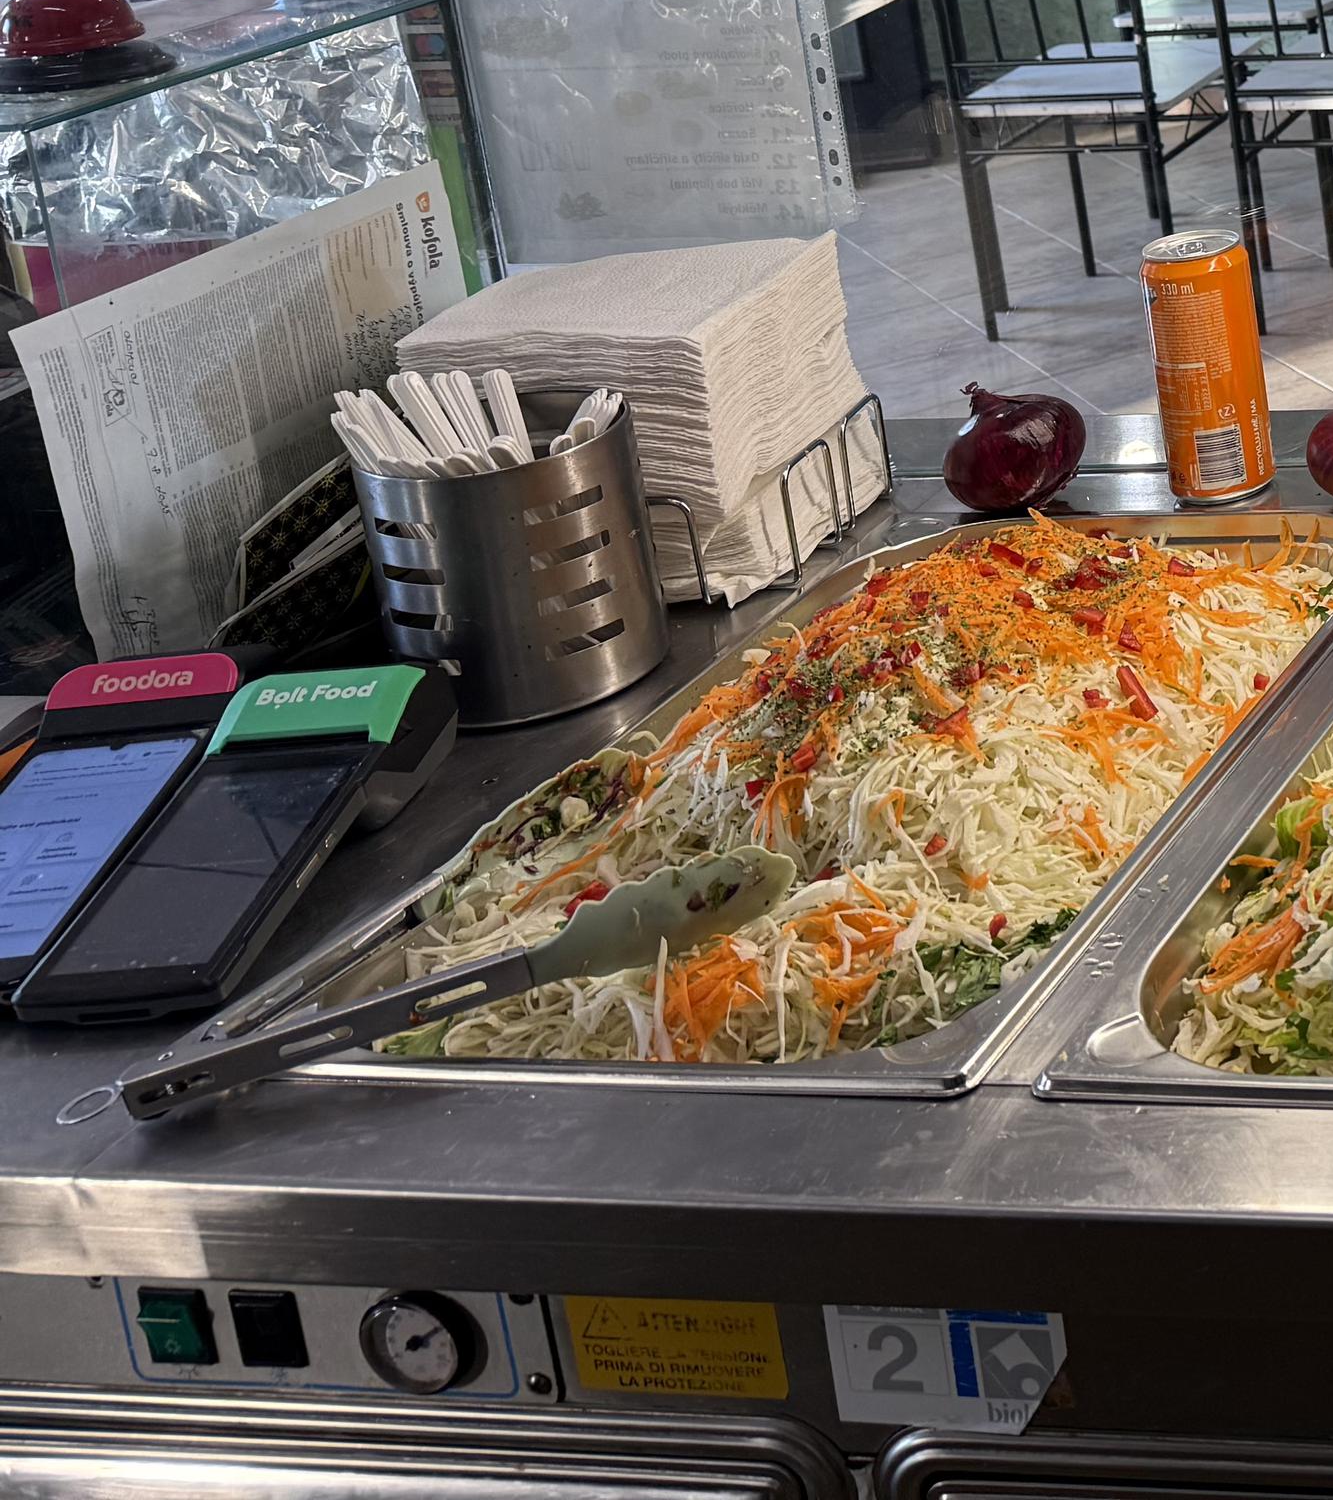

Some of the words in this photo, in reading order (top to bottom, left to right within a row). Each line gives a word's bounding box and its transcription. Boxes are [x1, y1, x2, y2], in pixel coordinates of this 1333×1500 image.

[396, 202, 414, 257] Smlouva
[420, 215, 443, 270] kofola
[1160, 283, 1178, 296] 330
[1180, 282, 1195, 295] ml
[92, 670, 194, 695] foodora
[255, 687, 308, 709] Bolt
[310, 681, 378, 702] Food
[594, 1359, 645, 1373] PRIMA
[649, 1359, 665, 1373] DI
[669, 1362, 765, 1378] RIMUOVERE
[867, 1324, 924, 1394] 2
[619, 1376, 640, 1388] LA
[643, 1377, 746, 1393] PROTEZIONE
